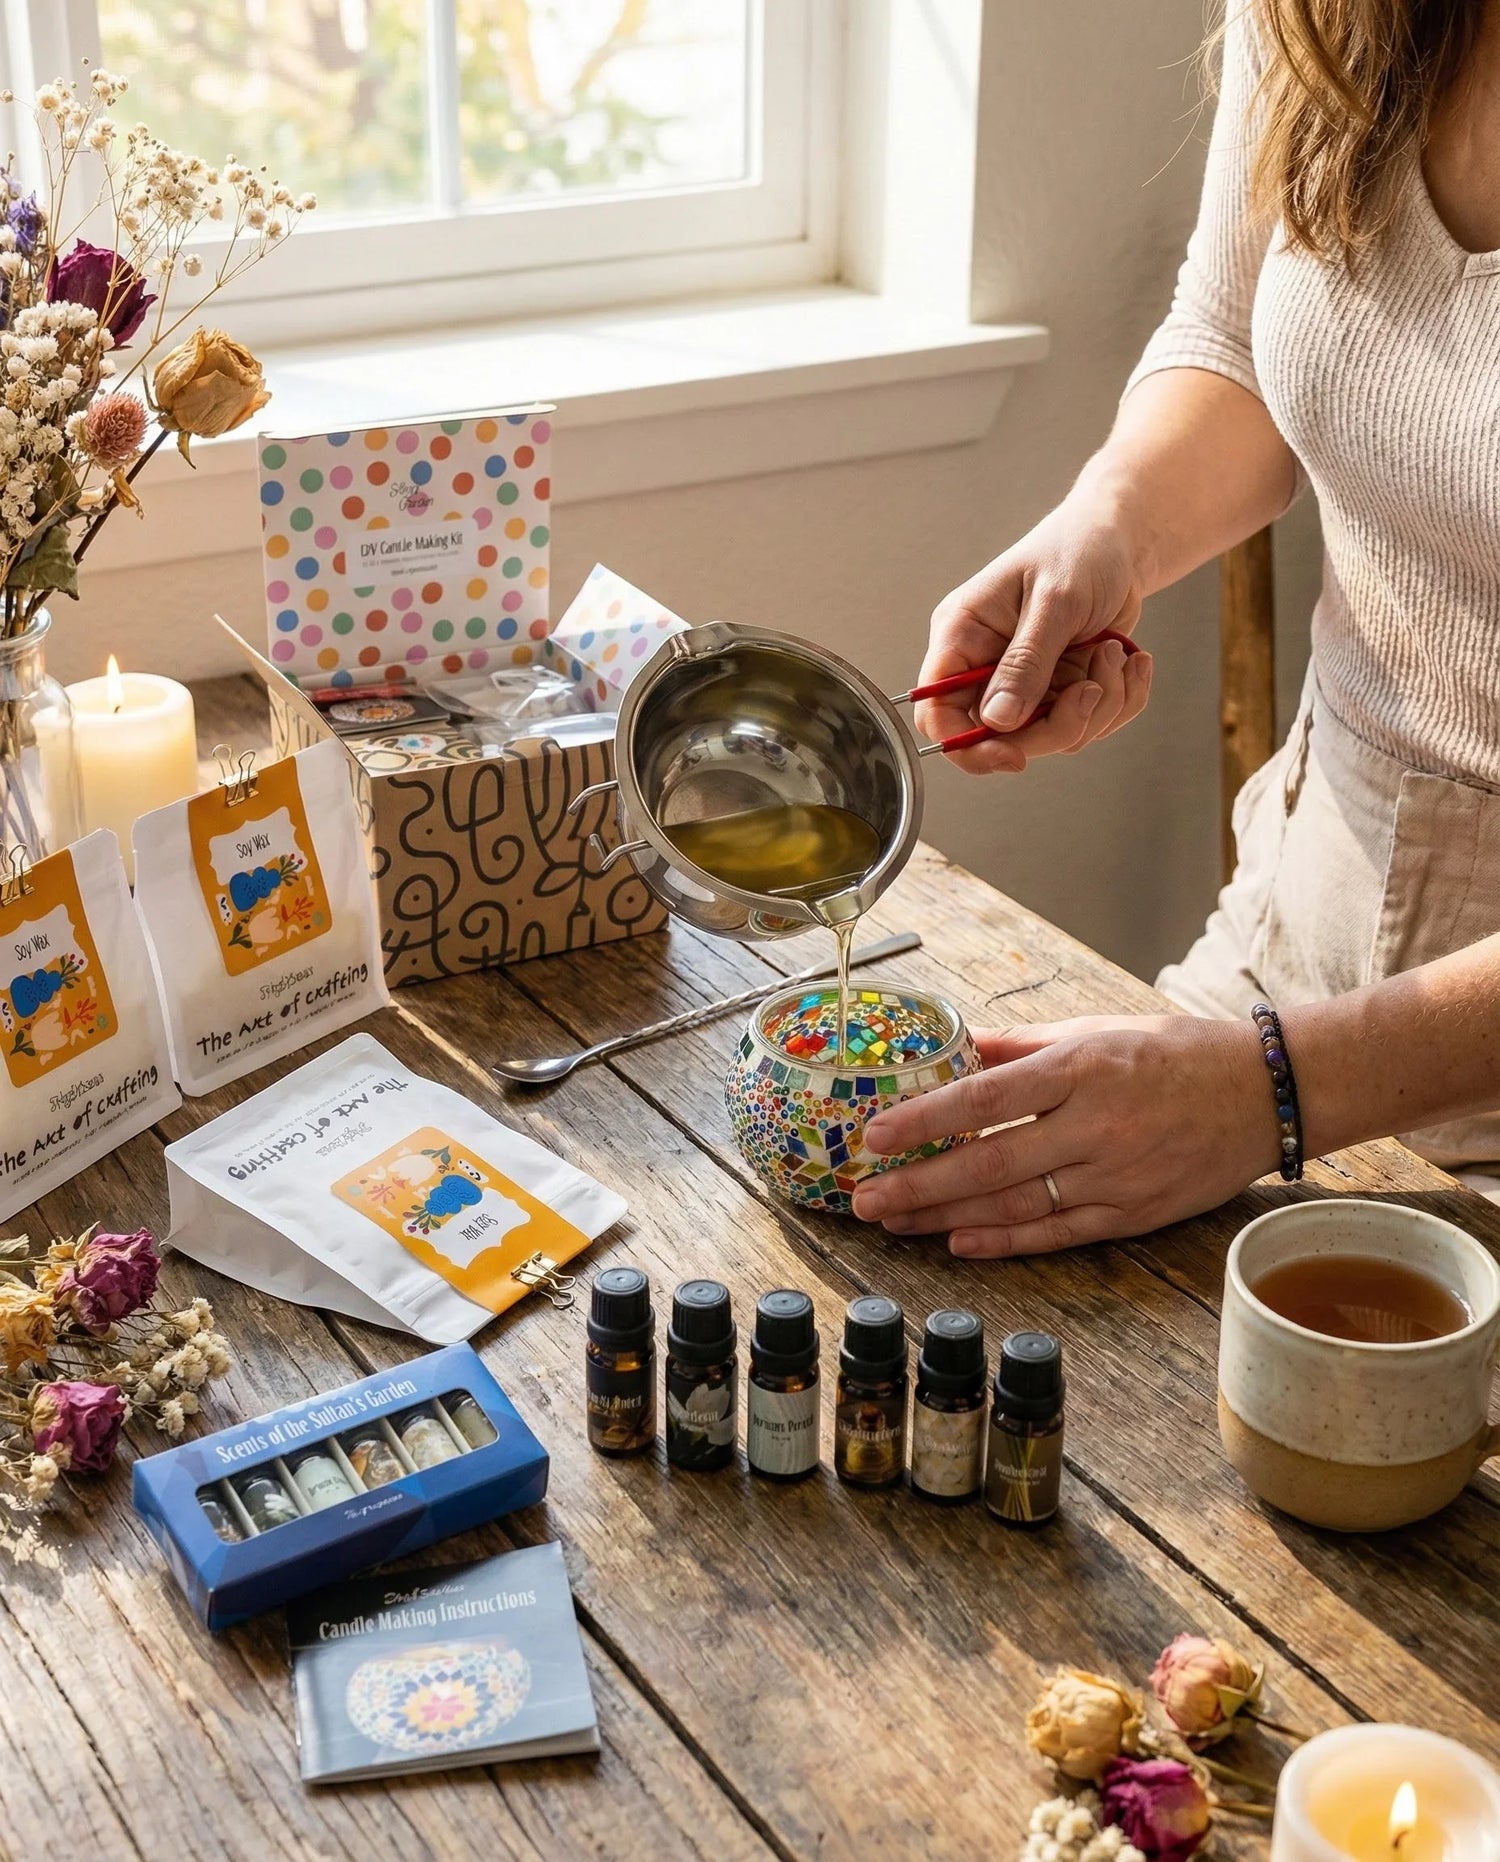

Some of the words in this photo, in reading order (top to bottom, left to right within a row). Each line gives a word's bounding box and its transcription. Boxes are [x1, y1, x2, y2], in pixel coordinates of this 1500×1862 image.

[415, 534, 448, 550] Making
[450, 531, 463, 545] Kit
[215, 1439, 268, 1464] Scents
[268, 1427, 285, 1446] of
[285, 1416, 307, 1436] the
[309, 1396, 366, 1429] Sultan's
[366, 1379, 417, 1408] Garden
[318, 1613, 375, 1641] Candle
[378, 1603, 437, 1631] Making
[439, 1589, 537, 1621] Instructions
